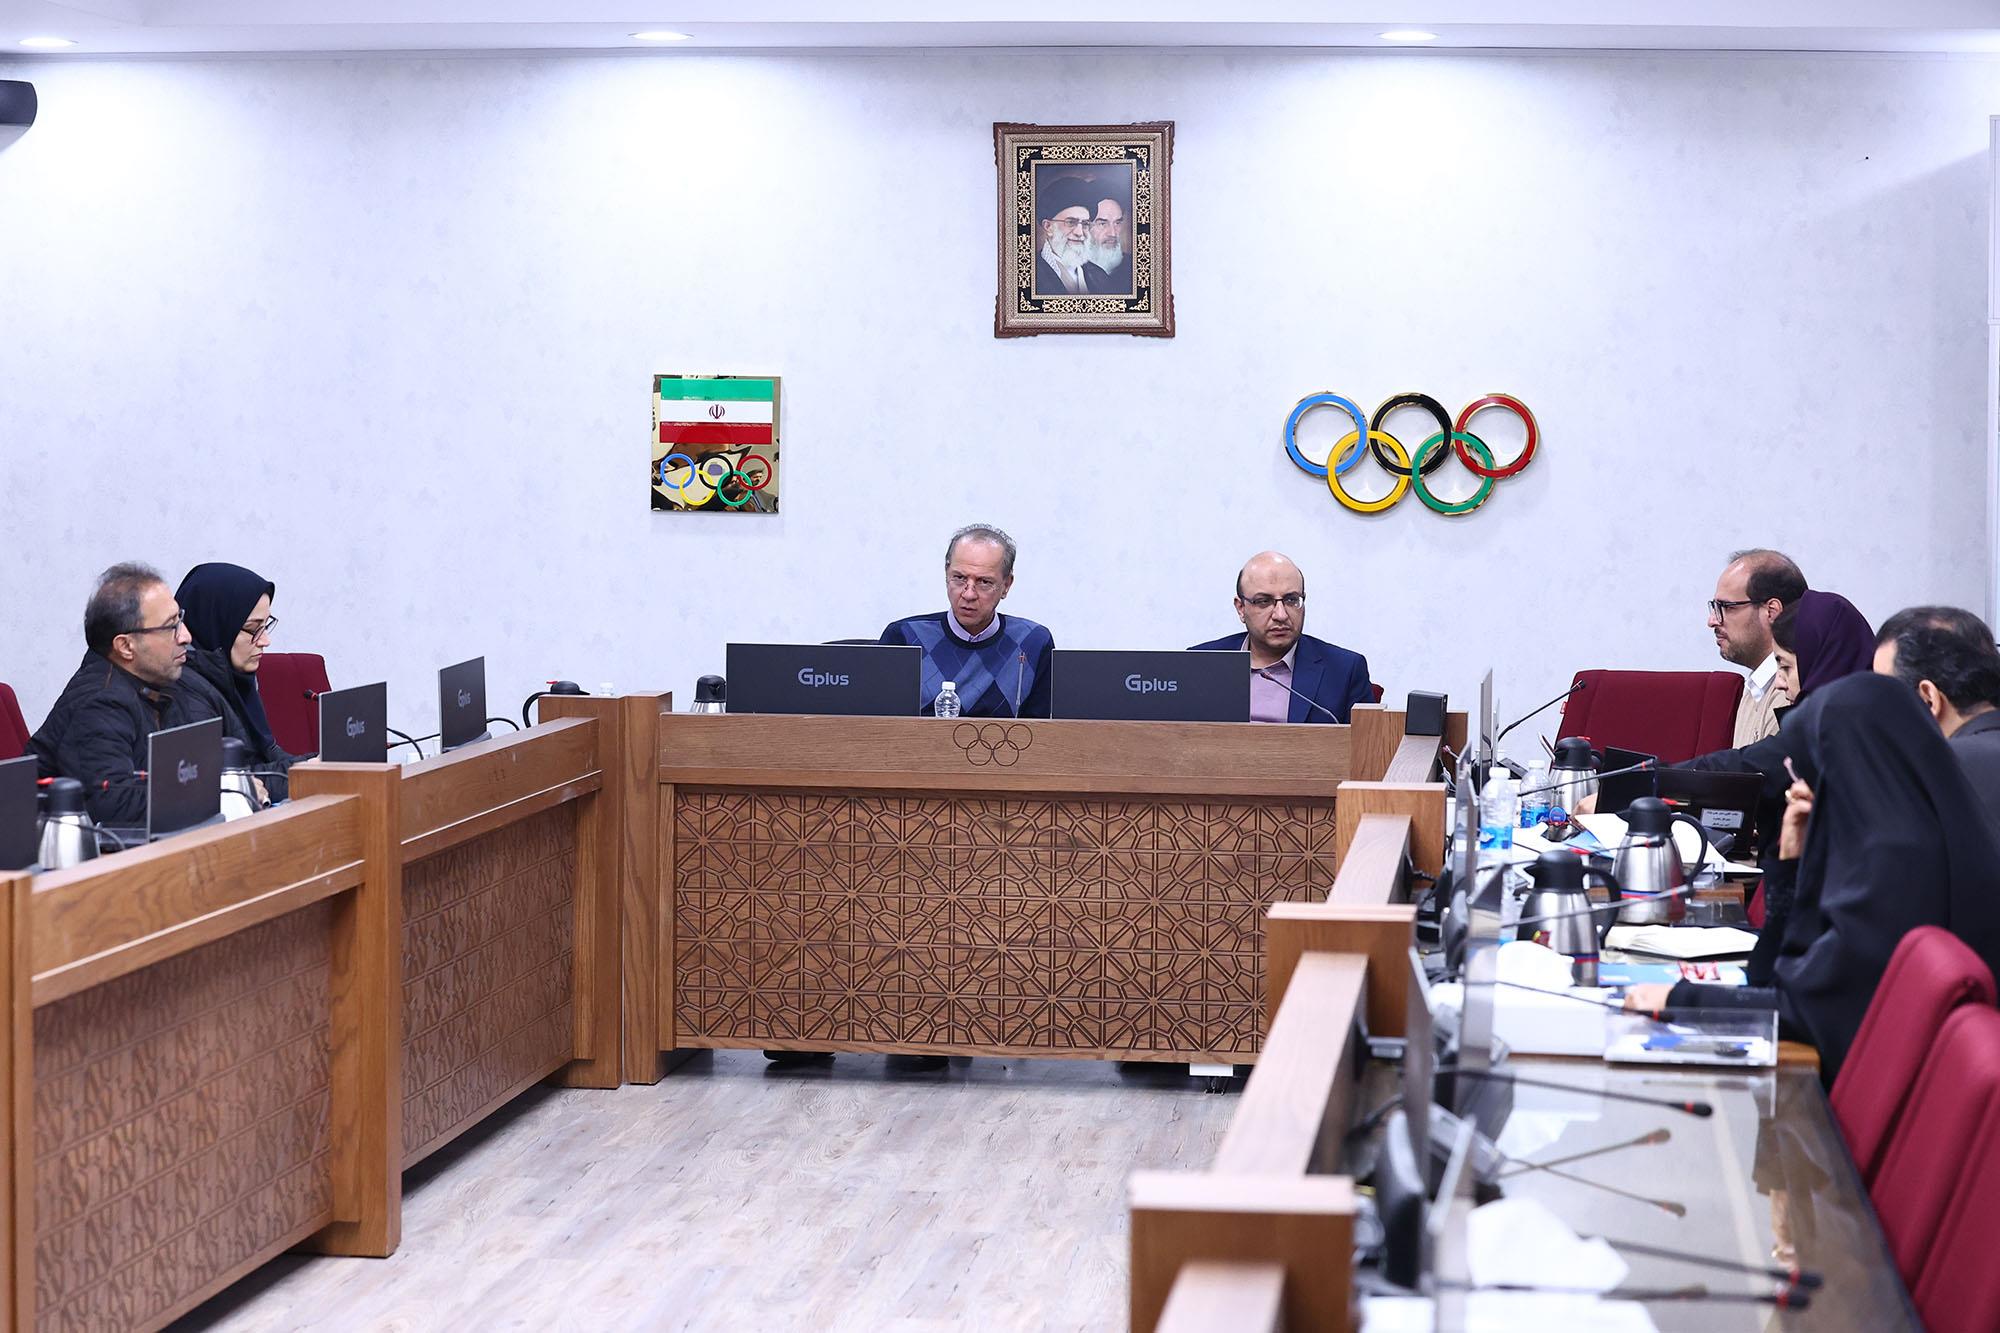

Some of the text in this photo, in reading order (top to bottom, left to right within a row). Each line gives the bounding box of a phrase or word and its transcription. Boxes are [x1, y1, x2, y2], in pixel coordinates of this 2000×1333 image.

[798, 667, 849, 687] Gplus
[1125, 674, 1178, 694] Gplus
[346, 716, 365, 738] Gplus
